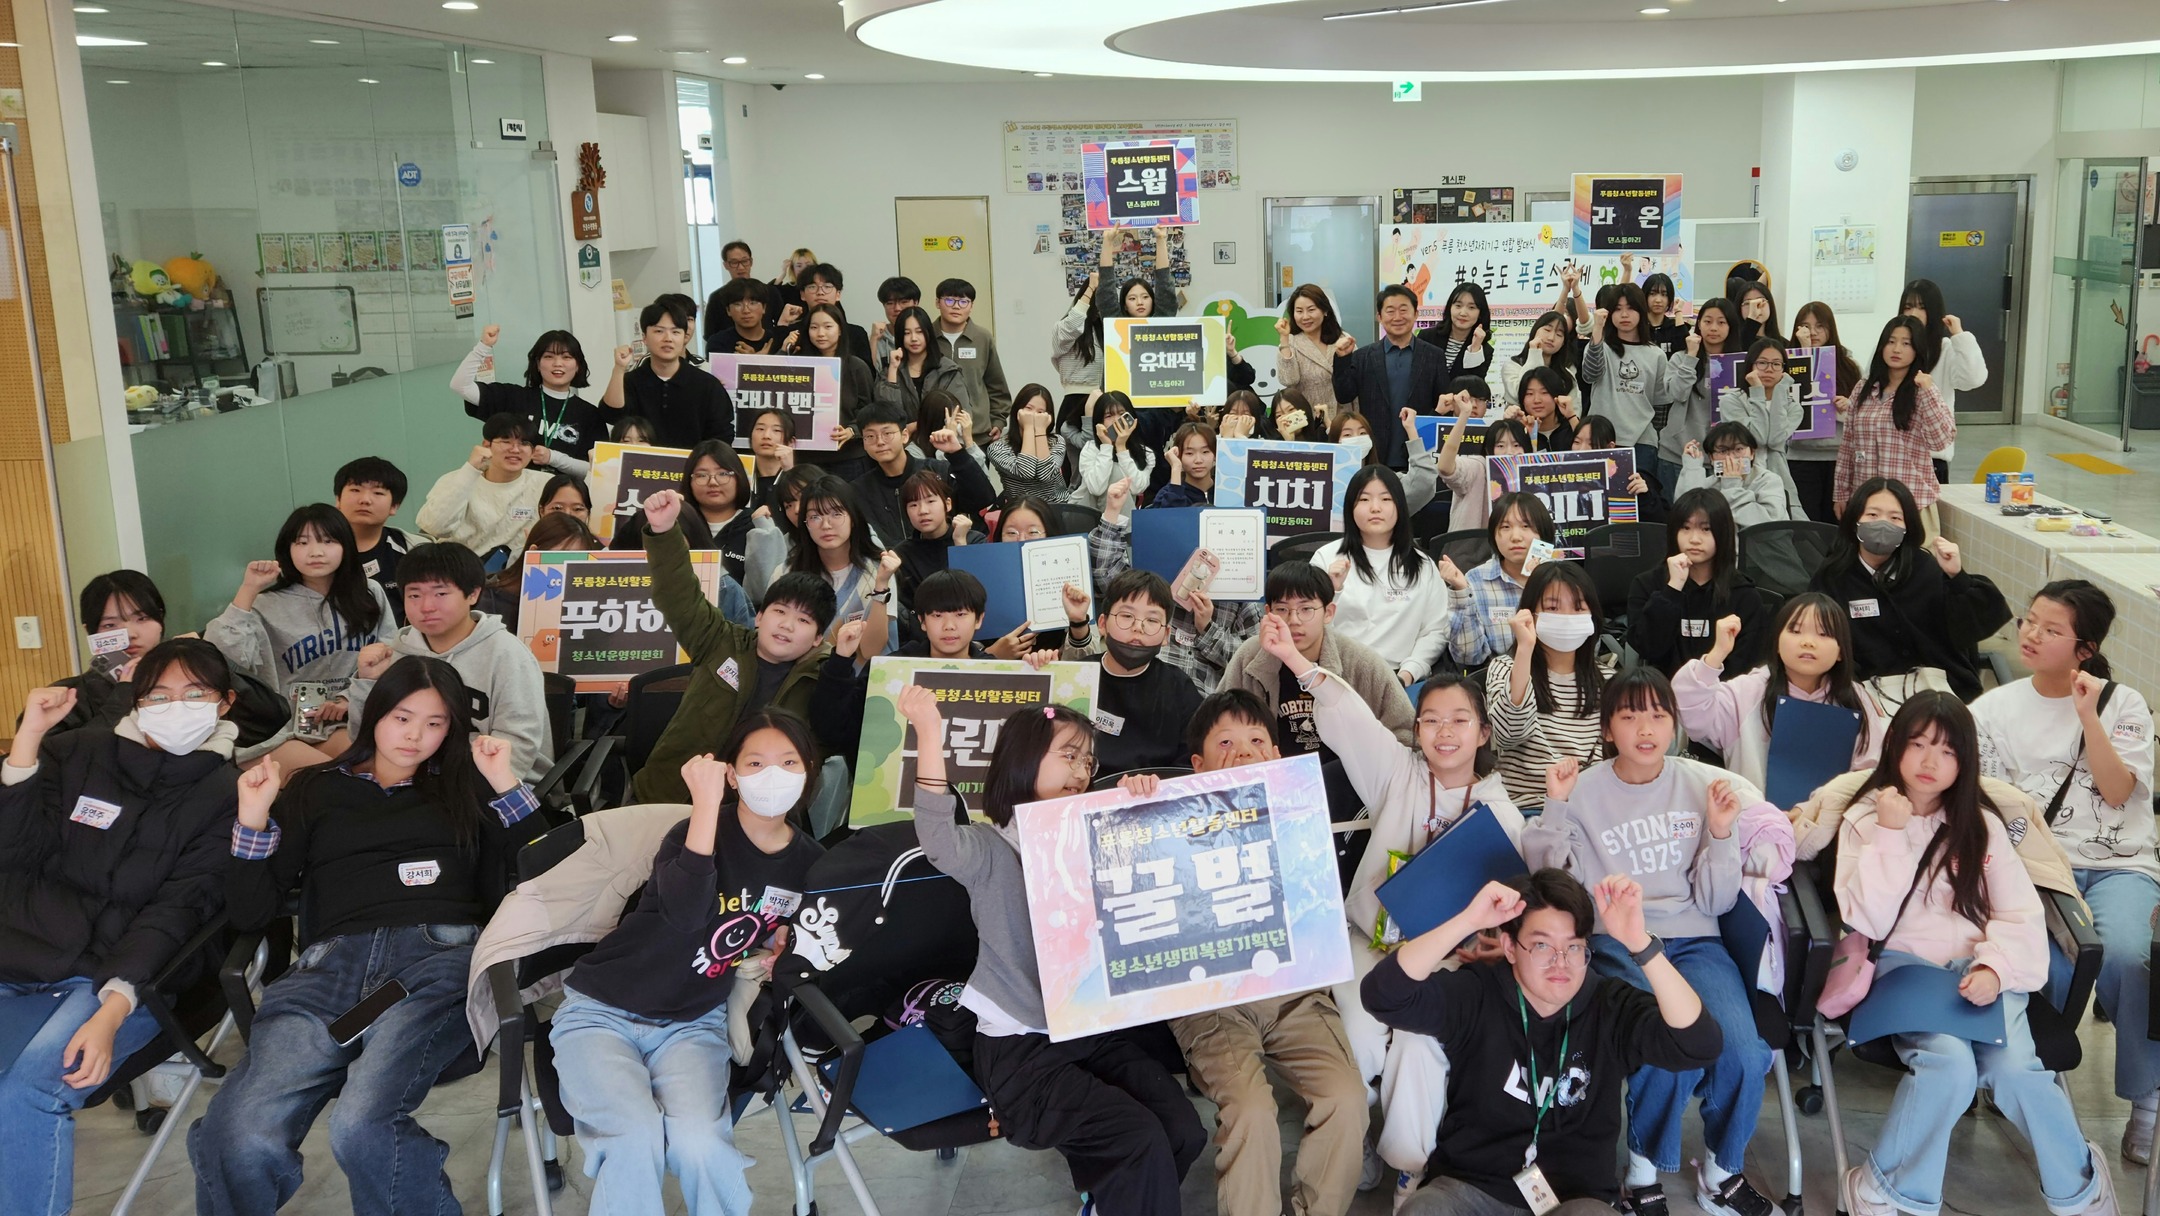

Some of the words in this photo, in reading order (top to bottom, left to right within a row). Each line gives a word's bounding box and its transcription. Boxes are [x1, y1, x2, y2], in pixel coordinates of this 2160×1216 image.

[401, 171, 418, 181] ADT
[1116, 167, 1167, 195] 스윕
[1126, 200, 1160, 209] 댄스동아리
[1420, 240, 1438, 257] ver.5
[1441, 238, 1454, 254] 푸름
[1134, 332, 1198, 342] 푸름청소년활동센터
[1138, 351, 1197, 372] 유채색
[743, 373, 810, 384] 푸름청소년활동센터
[1252, 460, 1328, 472] 푸름청소년활동센터
[1252, 476, 1326, 510] 치치
[725, 550, 746, 562] Jeep
[572, 649, 665, 662] 청소년운영위원회
[933, 689, 1041, 704] 름청소년활동센터
[2117, 723, 2142, 735] 이예은
[1099, 807, 1258, 851] 푸름청소년활동센터
[1673, 821, 1694, 832] 조수아
[1629, 840, 1683, 876] 1975
[406, 869, 433, 880] 강서희
[769, 896, 790, 908] 박지수
[1109, 929, 1287, 979] 청소년생태복원기획단
